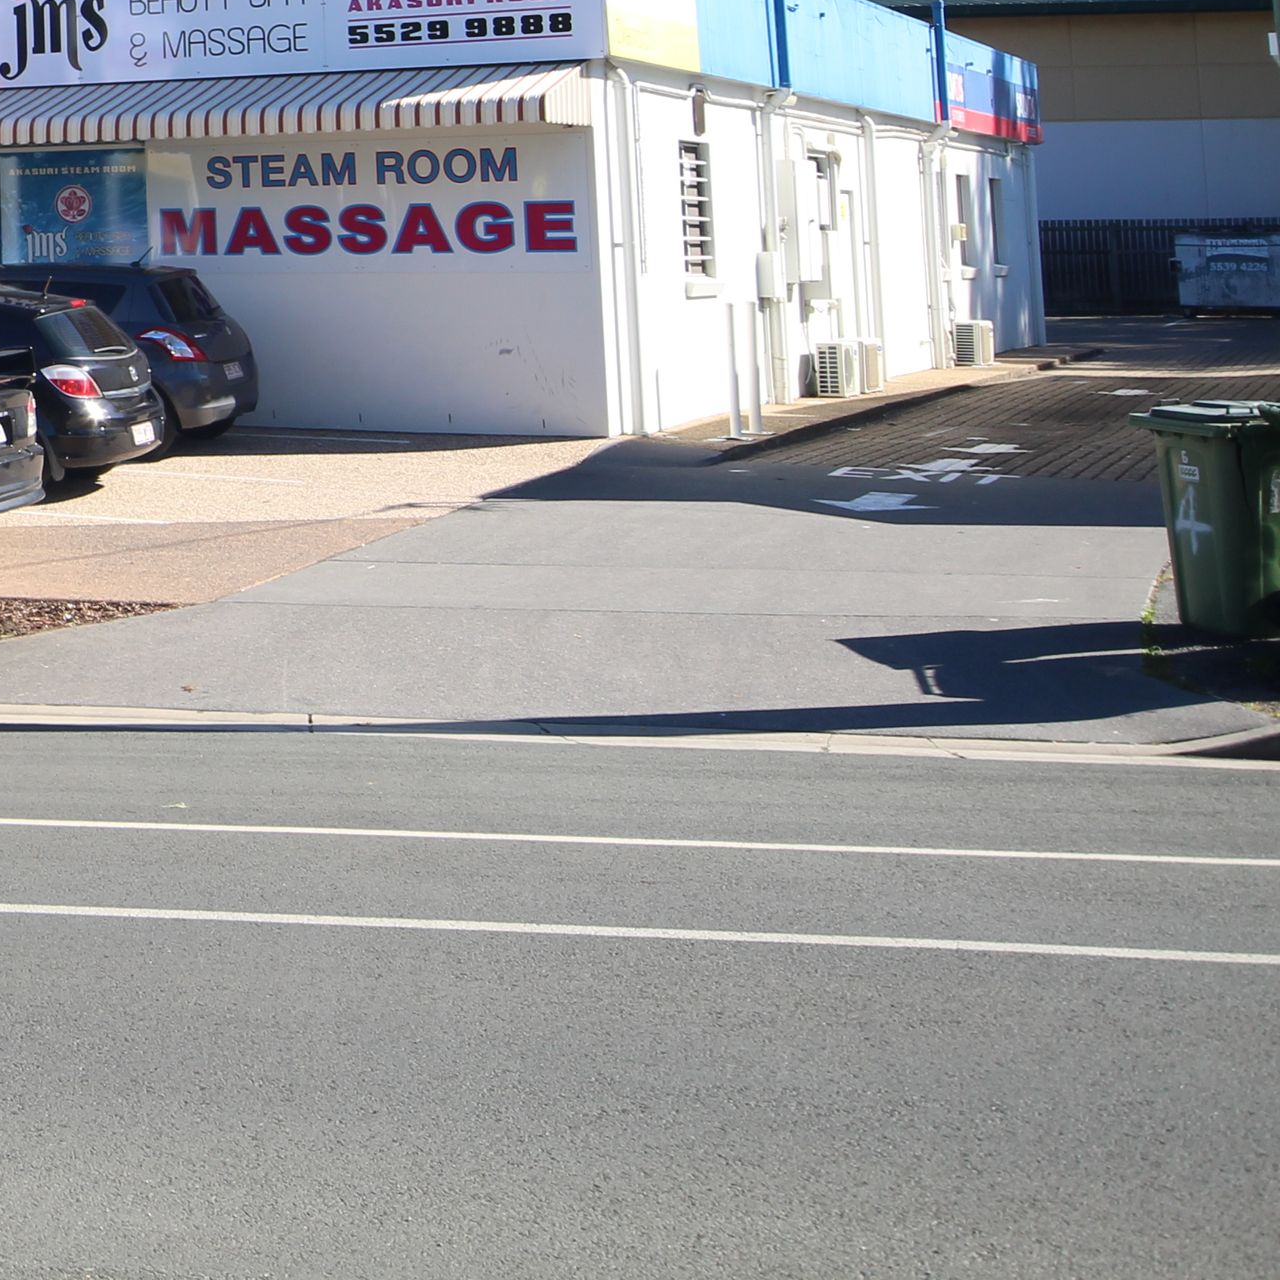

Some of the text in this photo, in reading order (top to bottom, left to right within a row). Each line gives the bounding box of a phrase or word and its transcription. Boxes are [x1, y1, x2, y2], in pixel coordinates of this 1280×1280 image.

[162, 23, 308, 59] MASSAGE
[348, 12, 572, 45] 5529 9888
[8, 165, 136, 176] AKASURI STEAM ROOM
[206, 147, 518, 189] STEAM ROOM
[159, 200, 578, 255] MASSAGE
[827, 466, 1021, 485] EXIT
